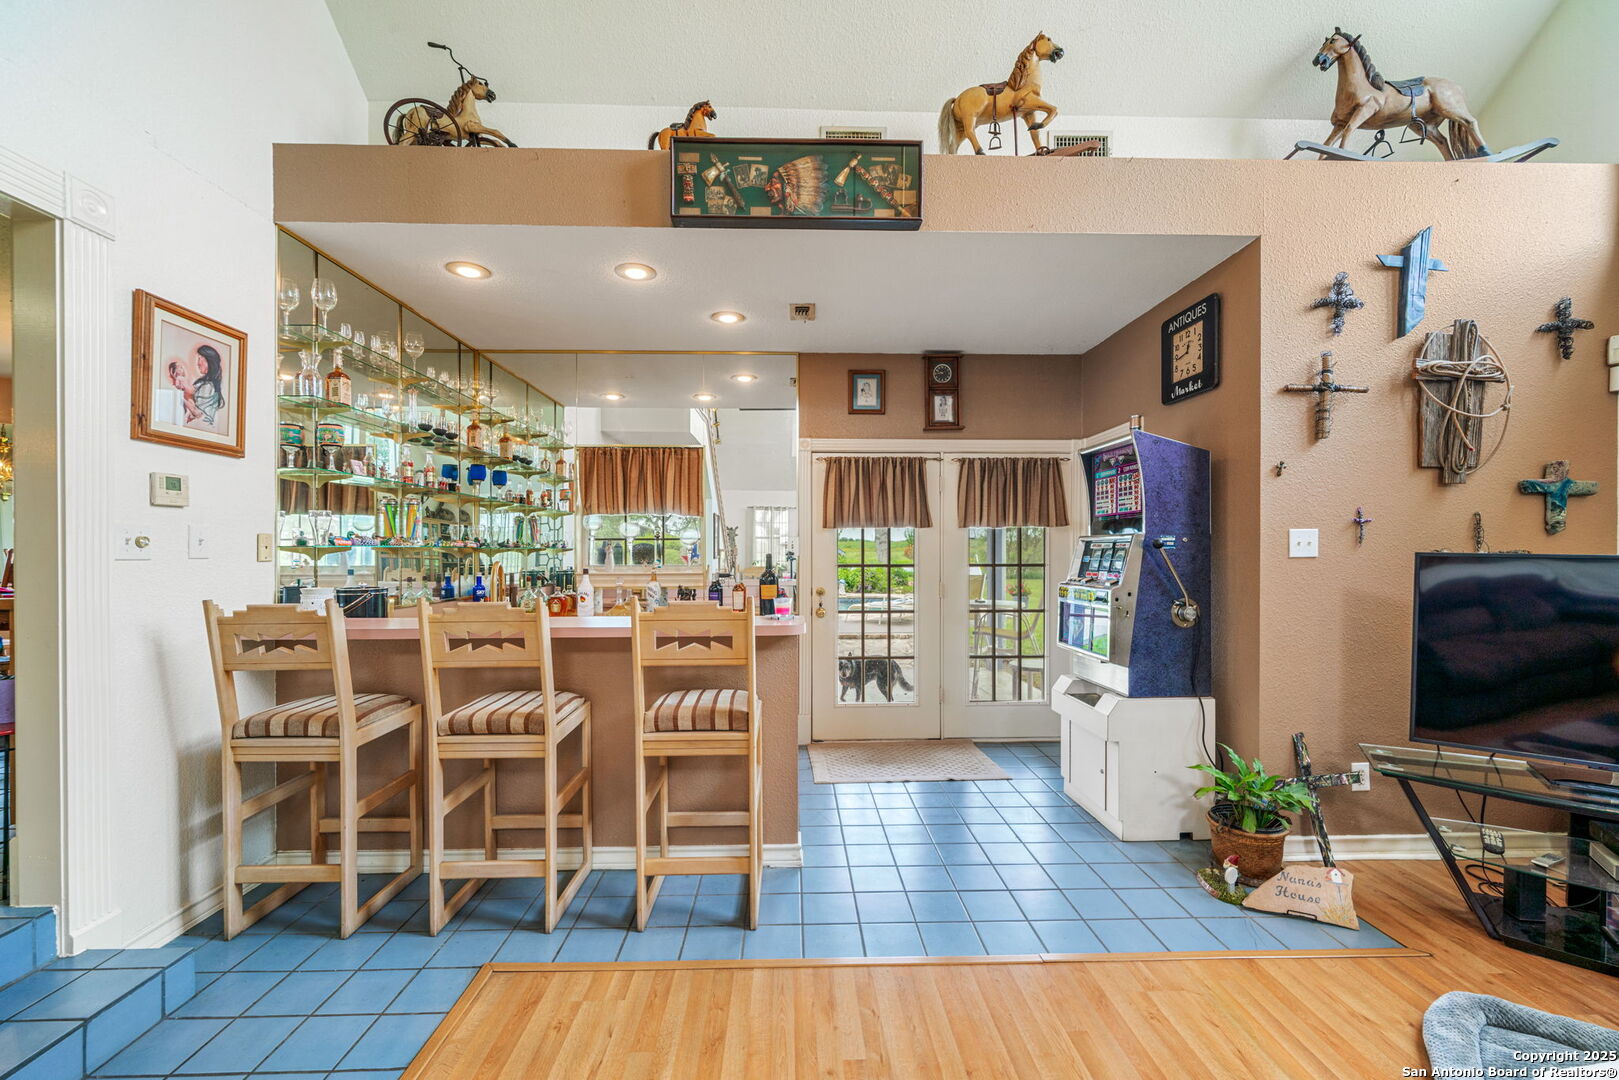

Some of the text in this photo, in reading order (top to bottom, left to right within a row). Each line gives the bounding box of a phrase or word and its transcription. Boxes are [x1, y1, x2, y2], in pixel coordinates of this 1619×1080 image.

[1168, 302, 1207, 334] ANTIQUES
[1185, 329, 1191, 338] 12
[1197, 333, 1202, 341] 2
[1192, 364, 1197, 372] 5
[1171, 379, 1203, 399] Market
[1275, 885, 1321, 904] House
